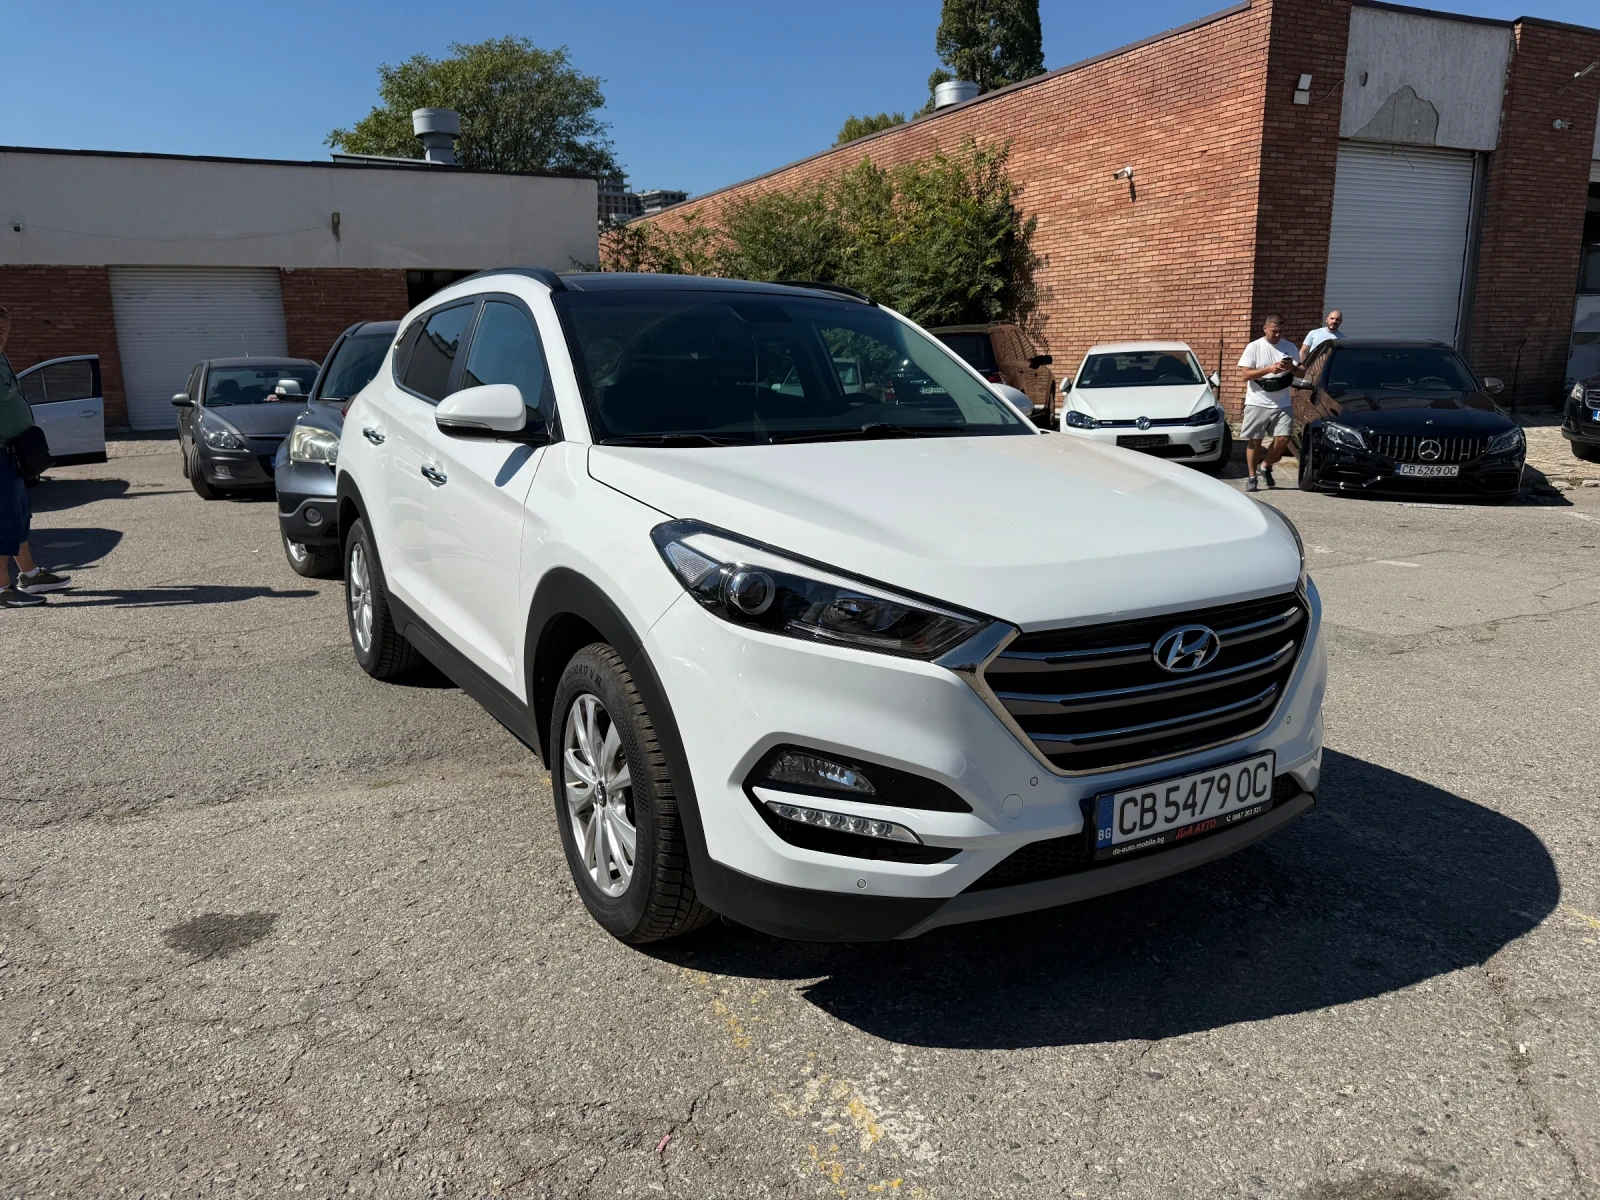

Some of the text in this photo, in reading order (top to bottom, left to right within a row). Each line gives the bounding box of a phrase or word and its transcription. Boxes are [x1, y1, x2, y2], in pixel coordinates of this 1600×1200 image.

[1402, 465, 1416, 474] CB
[1418, 466, 1442, 475] 6269
[1119, 762, 1268, 835] CB 5479 OC
[1098, 828, 1111, 840] BG
